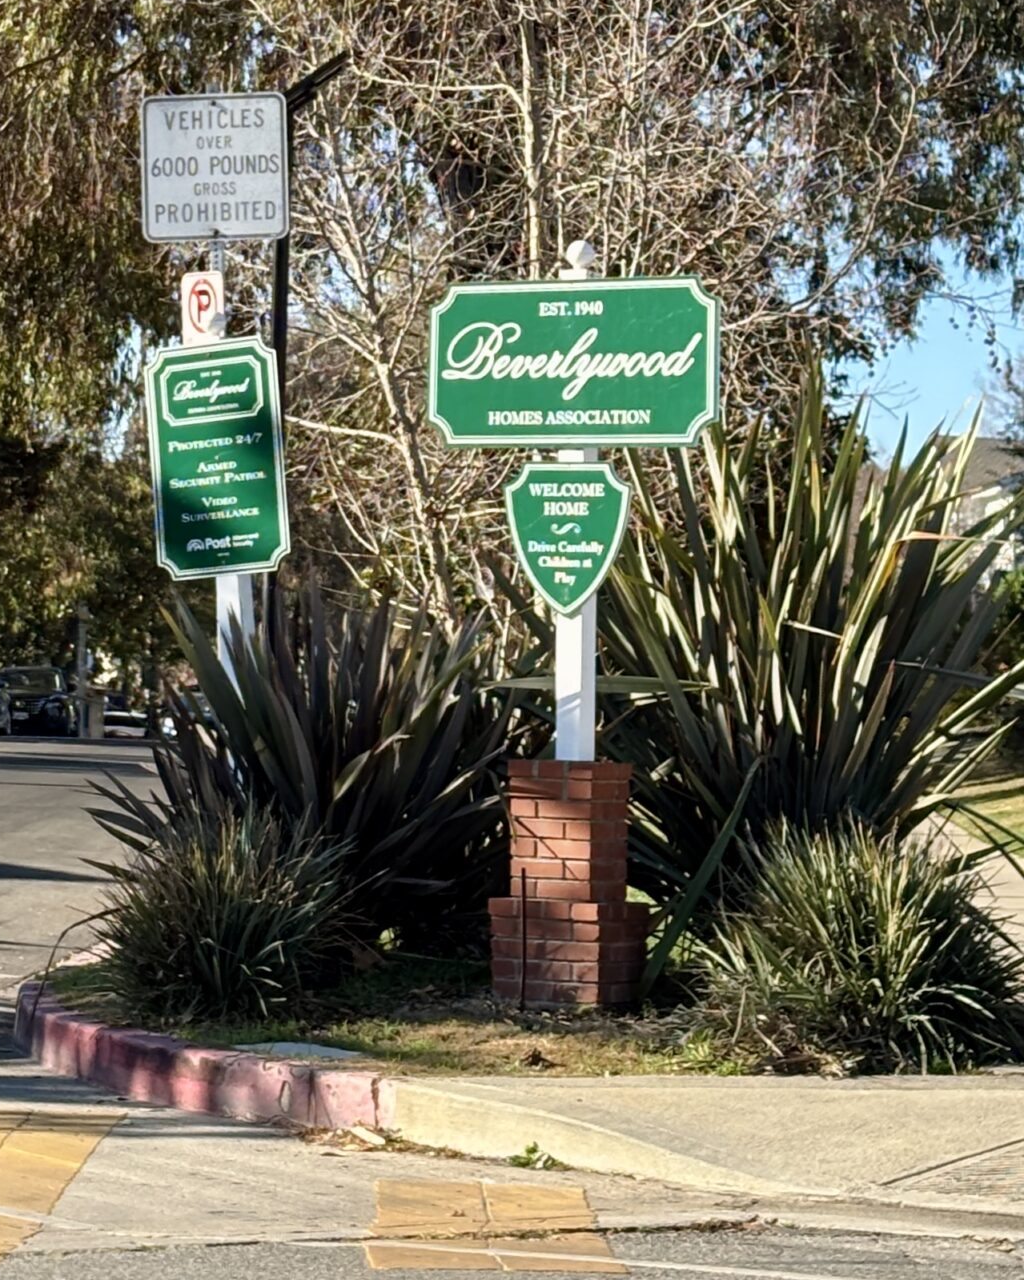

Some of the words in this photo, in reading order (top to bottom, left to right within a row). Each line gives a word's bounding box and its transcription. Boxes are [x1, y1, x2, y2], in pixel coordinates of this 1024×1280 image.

[164, 108, 265, 131] VEHICLES
[196, 135, 233, 150] OVER
[150, 156, 199, 178] 6000
[209, 154, 280, 176] POUNDS
[193, 181, 237, 196] GROSS
[154, 201, 277, 224] PROHIBITED
[538, 301, 572, 317] EST.
[574, 300, 604, 316] 1940
[441, 322, 703, 401] Beverlywood
[488, 411, 543, 426] HOMES
[545, 409, 651, 425] ASSOCIATION
[234, 432, 263, 445] 24/7
[528, 483, 606, 497] WELCOME
[543, 501, 590, 516] HOME
[527, 540, 557, 553] Drive
[557, 540, 605, 556] Carefully
[554, 571, 577, 586] Play
